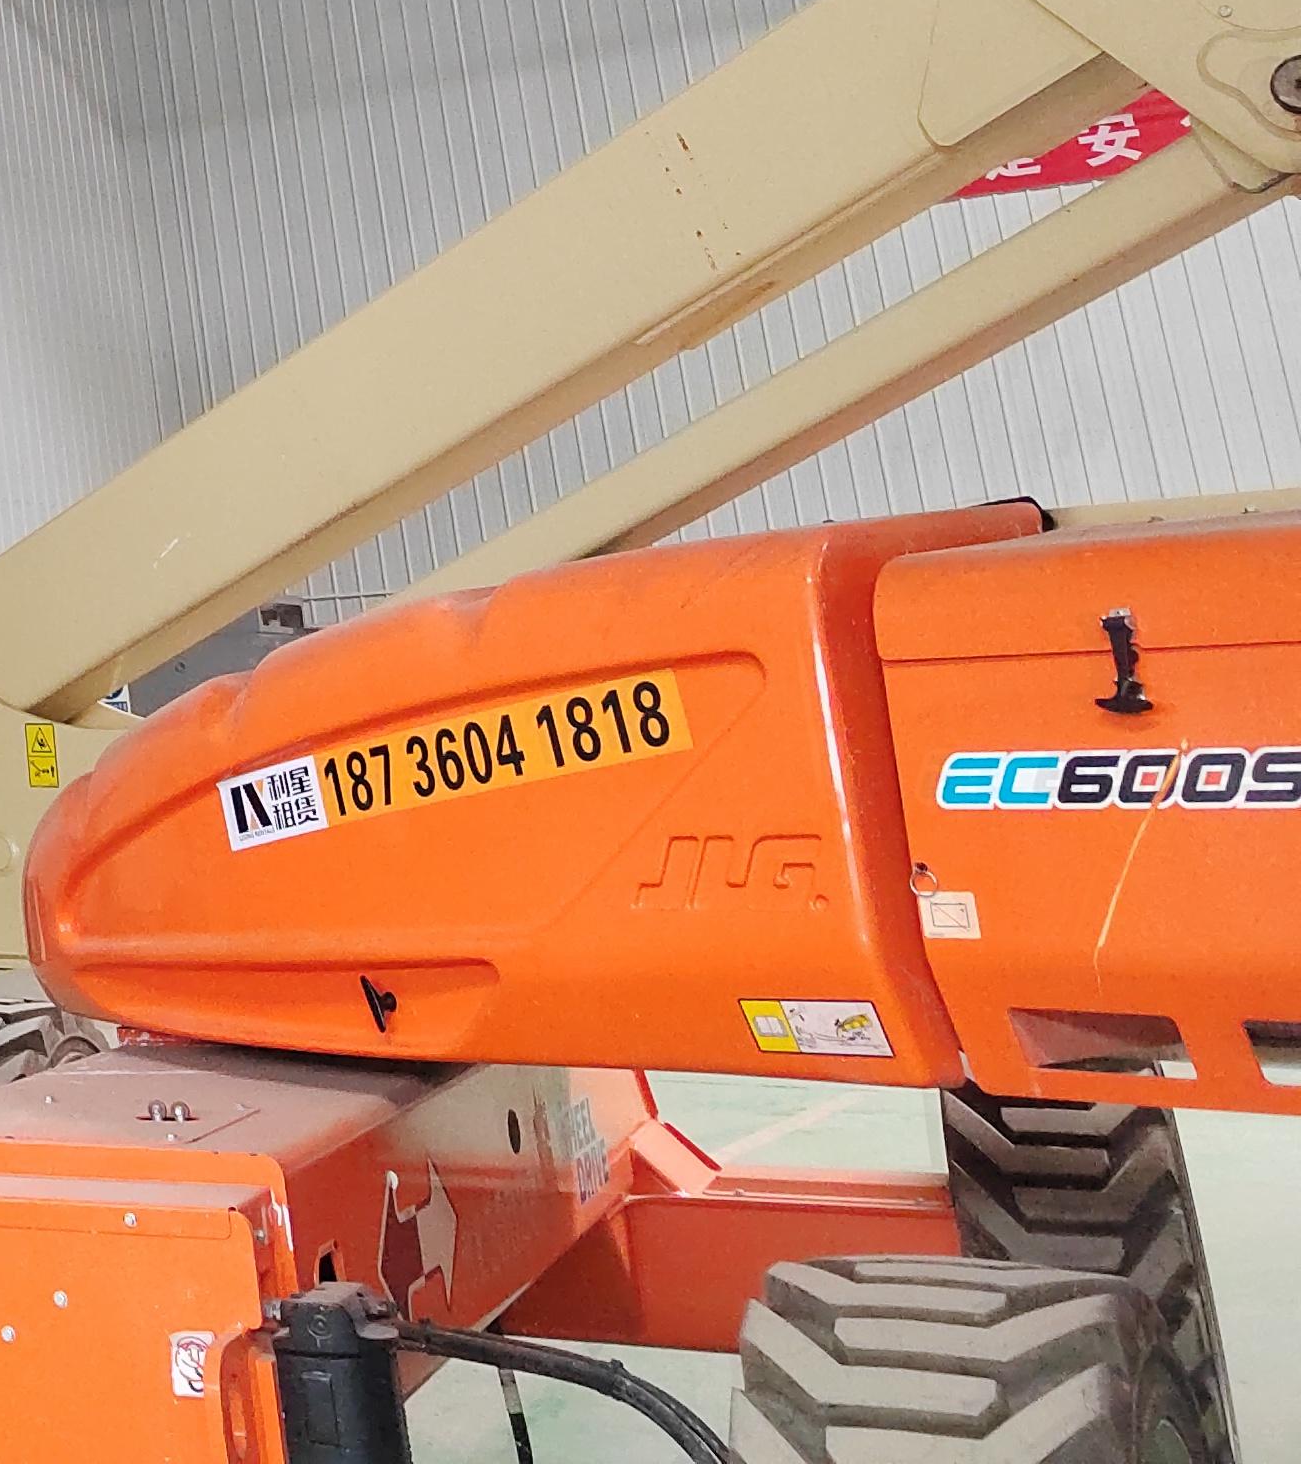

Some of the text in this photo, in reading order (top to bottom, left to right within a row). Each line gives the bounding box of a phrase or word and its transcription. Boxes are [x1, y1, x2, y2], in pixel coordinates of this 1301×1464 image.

[325, 681, 670, 817] 187 3604 1818
[942, 751, 1301, 804] EC600S
[266, 766, 314, 801] 利星
[272, 795, 319, 830] 租赁
[631, 834, 822, 912] JLG
[576, 1137, 609, 1205] DRIVE
